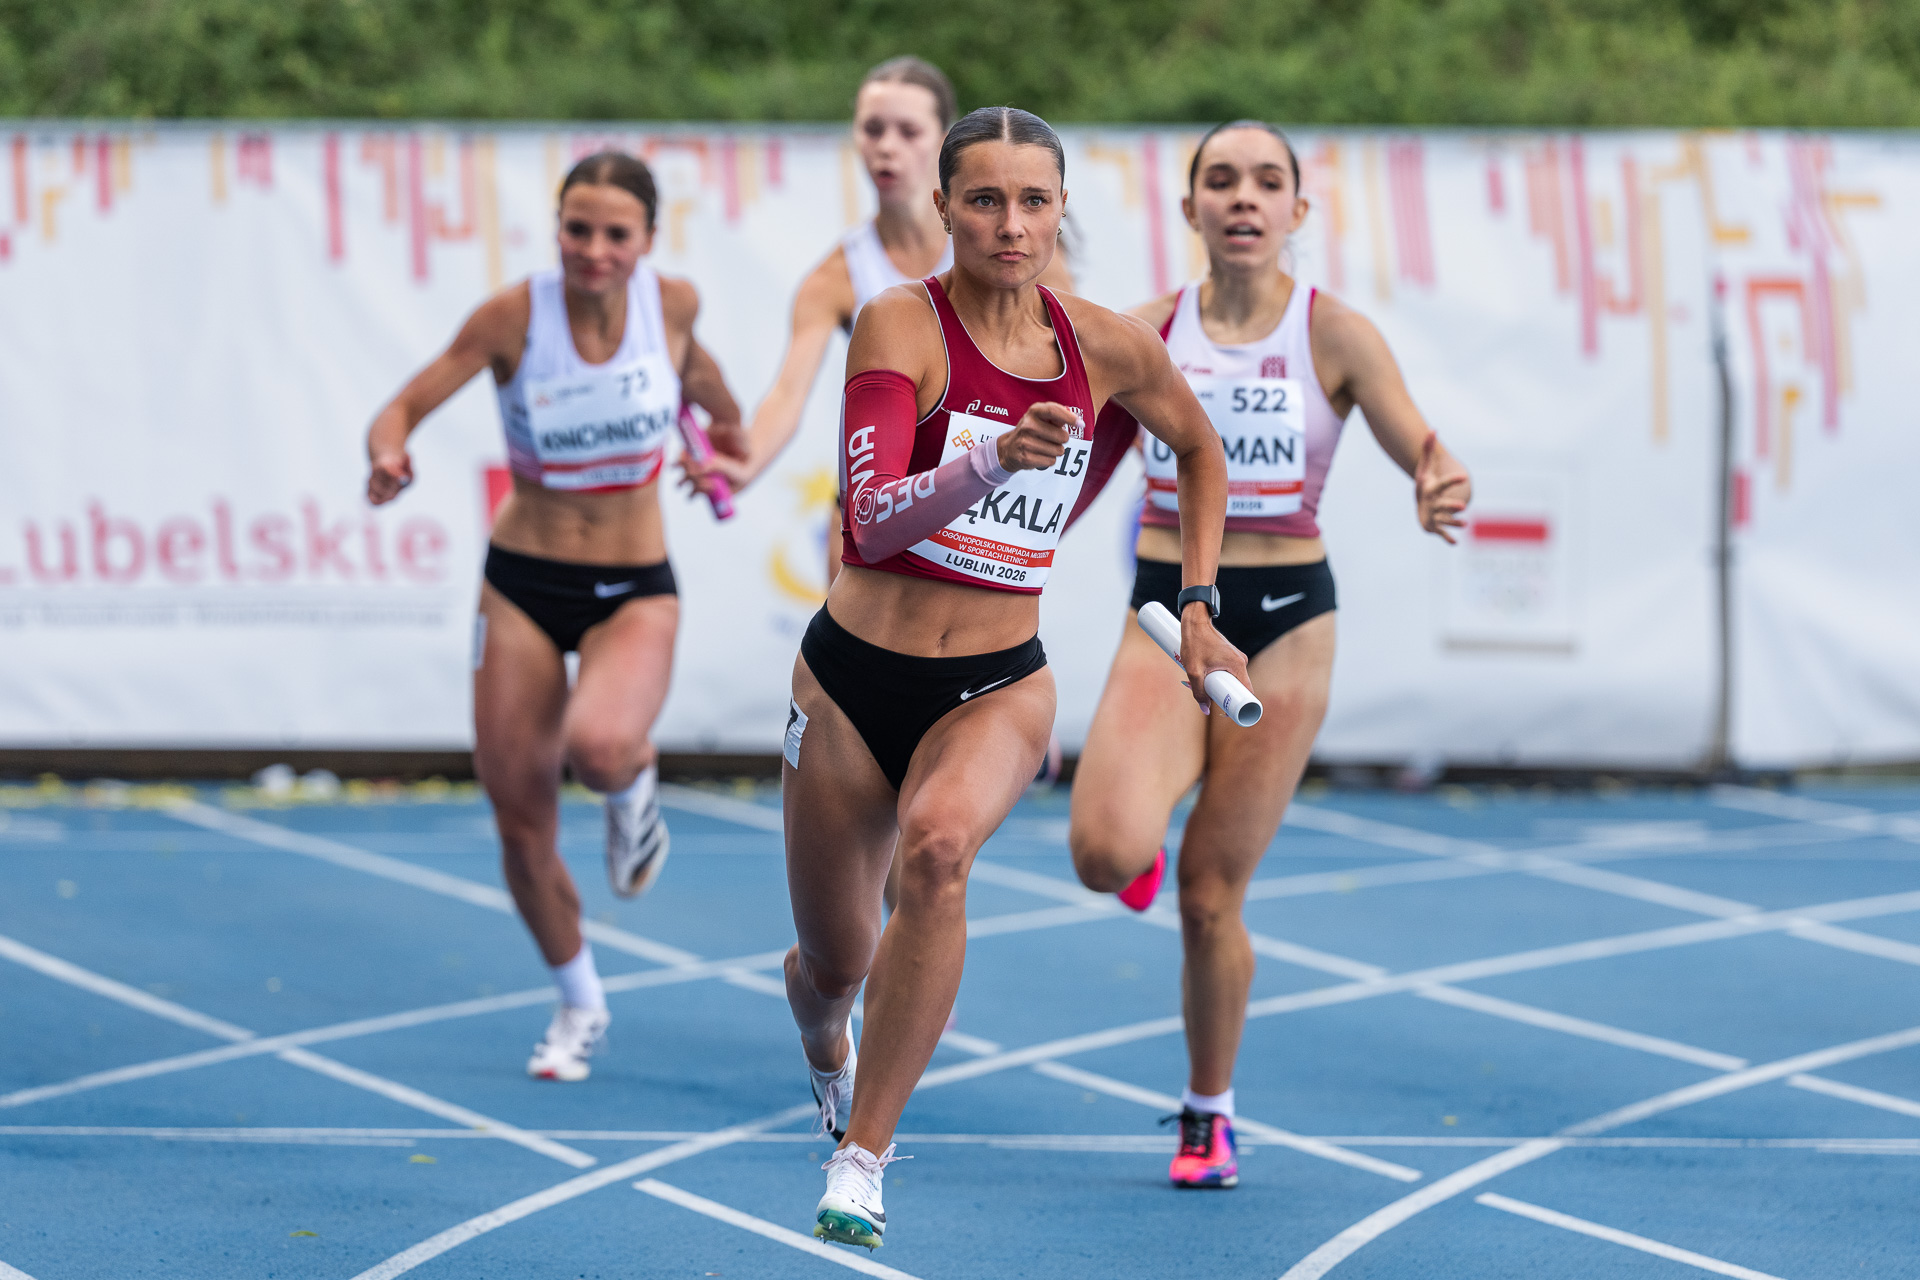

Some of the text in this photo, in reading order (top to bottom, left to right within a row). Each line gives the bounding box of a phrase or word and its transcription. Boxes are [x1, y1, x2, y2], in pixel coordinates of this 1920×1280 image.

[984, 404, 1009, 417] CUNA
[1232, 387, 1287, 413] 522
[1036, 447, 1088, 478] 15
[0, 495, 448, 586] ubelskie
[942, 530, 996, 550] OGÓLNOPOLSKA
[997, 544, 1030, 558] OLIMPIADA
[958, 543, 1029, 566] W SPORTACH LETNICH
[945, 552, 1027, 582] LUBLIN 2026
